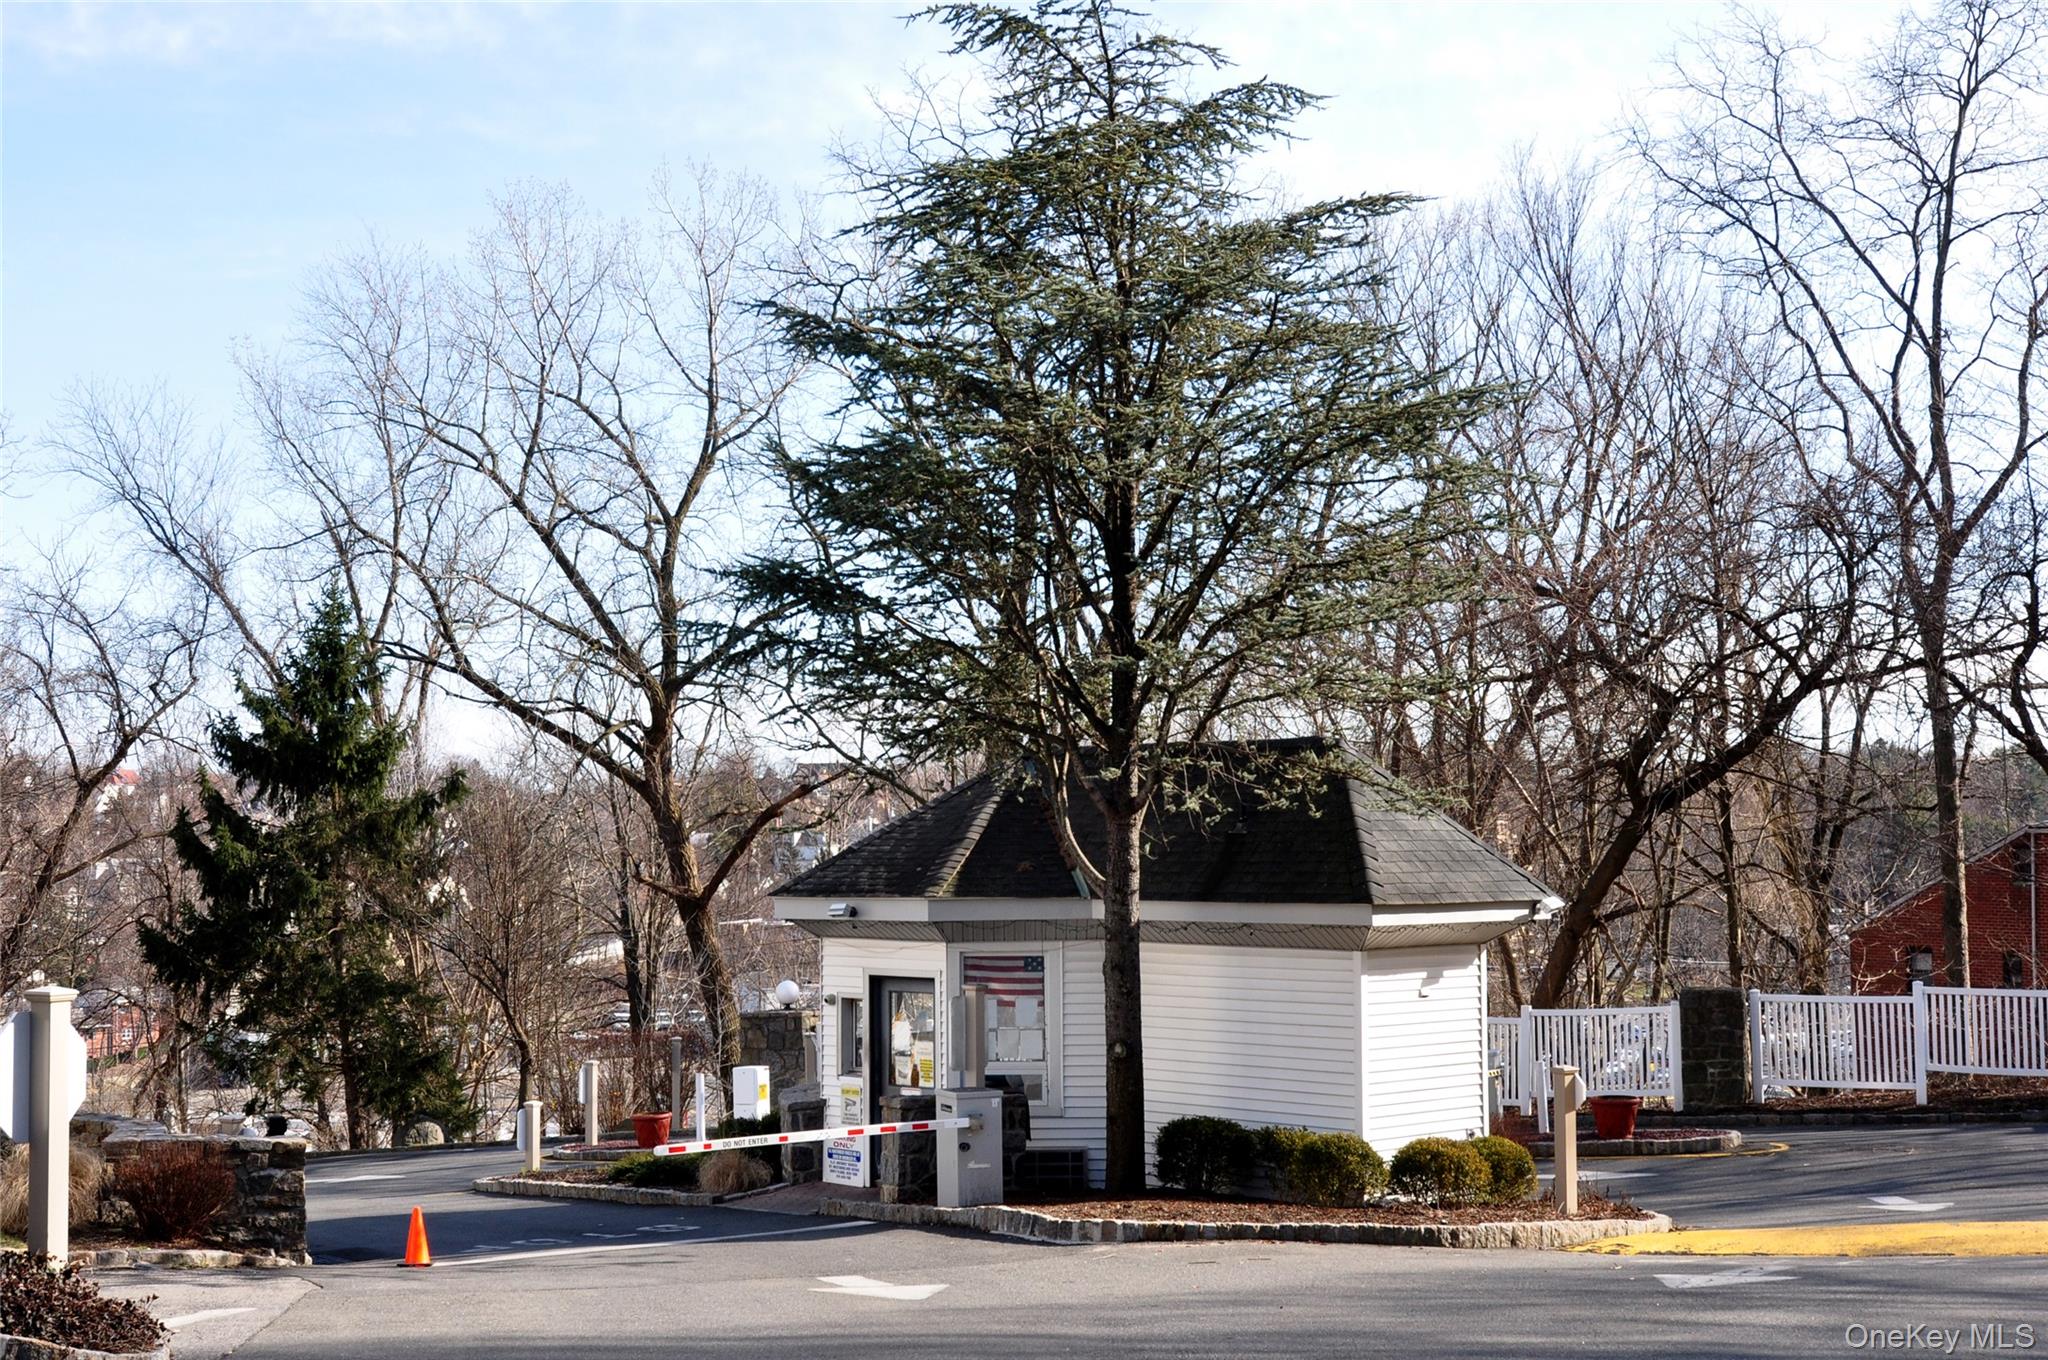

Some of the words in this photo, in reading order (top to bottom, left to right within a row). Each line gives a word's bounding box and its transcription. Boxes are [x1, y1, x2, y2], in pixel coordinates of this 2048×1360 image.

[722, 1141, 732, 1149] DO
[733, 1139, 747, 1147] NOT
[748, 1137, 769, 1146] ENTER
[832, 1140, 855, 1149] ONLY
